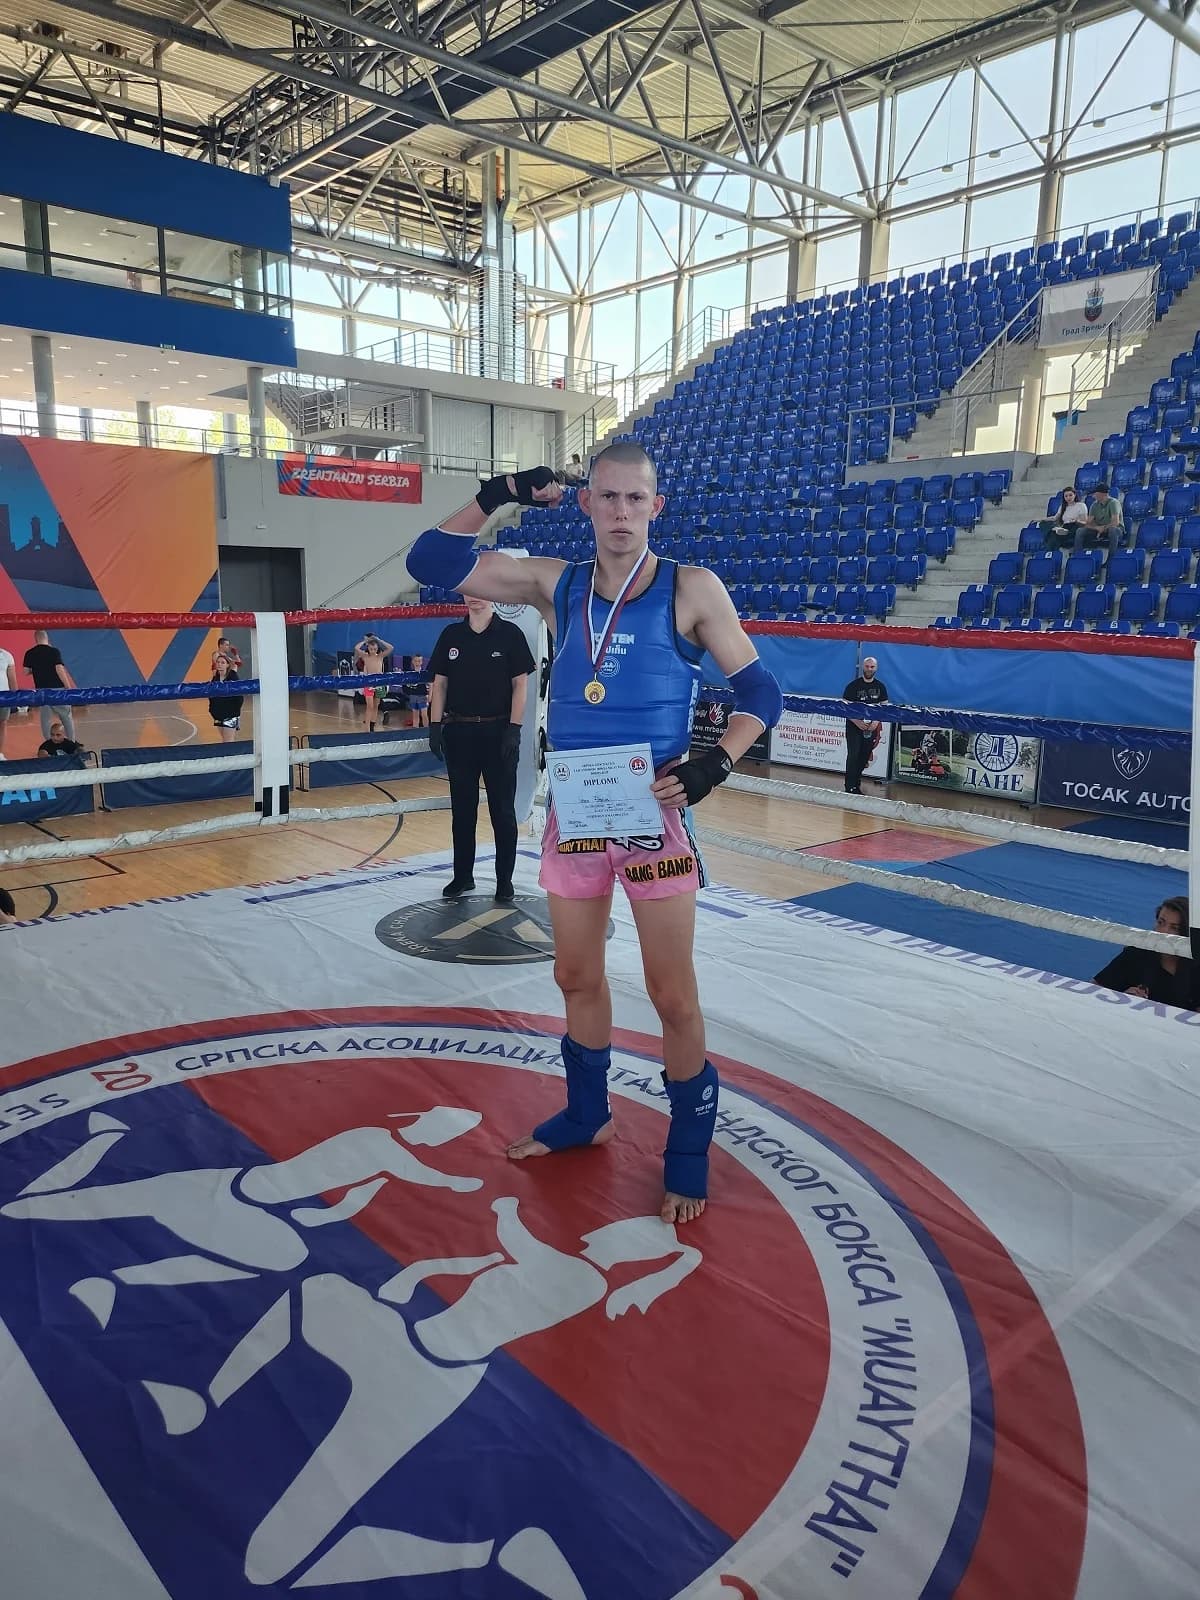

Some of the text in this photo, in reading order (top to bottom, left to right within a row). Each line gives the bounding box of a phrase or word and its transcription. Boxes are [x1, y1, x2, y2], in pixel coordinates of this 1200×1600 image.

[291, 467, 410, 488] ZRENJANIN SERBIA
[612, 633, 635, 645] TEN
[963, 767, 1024, 793] ДАНЕ
[1062, 781, 1130, 804] TOČAK
[576, 839, 604, 852] THAI
[625, 857, 693, 882] BANG BANG
[175, 1040, 329, 1071] СРПСКА
[811, 1202, 903, 1306] БОКСА
